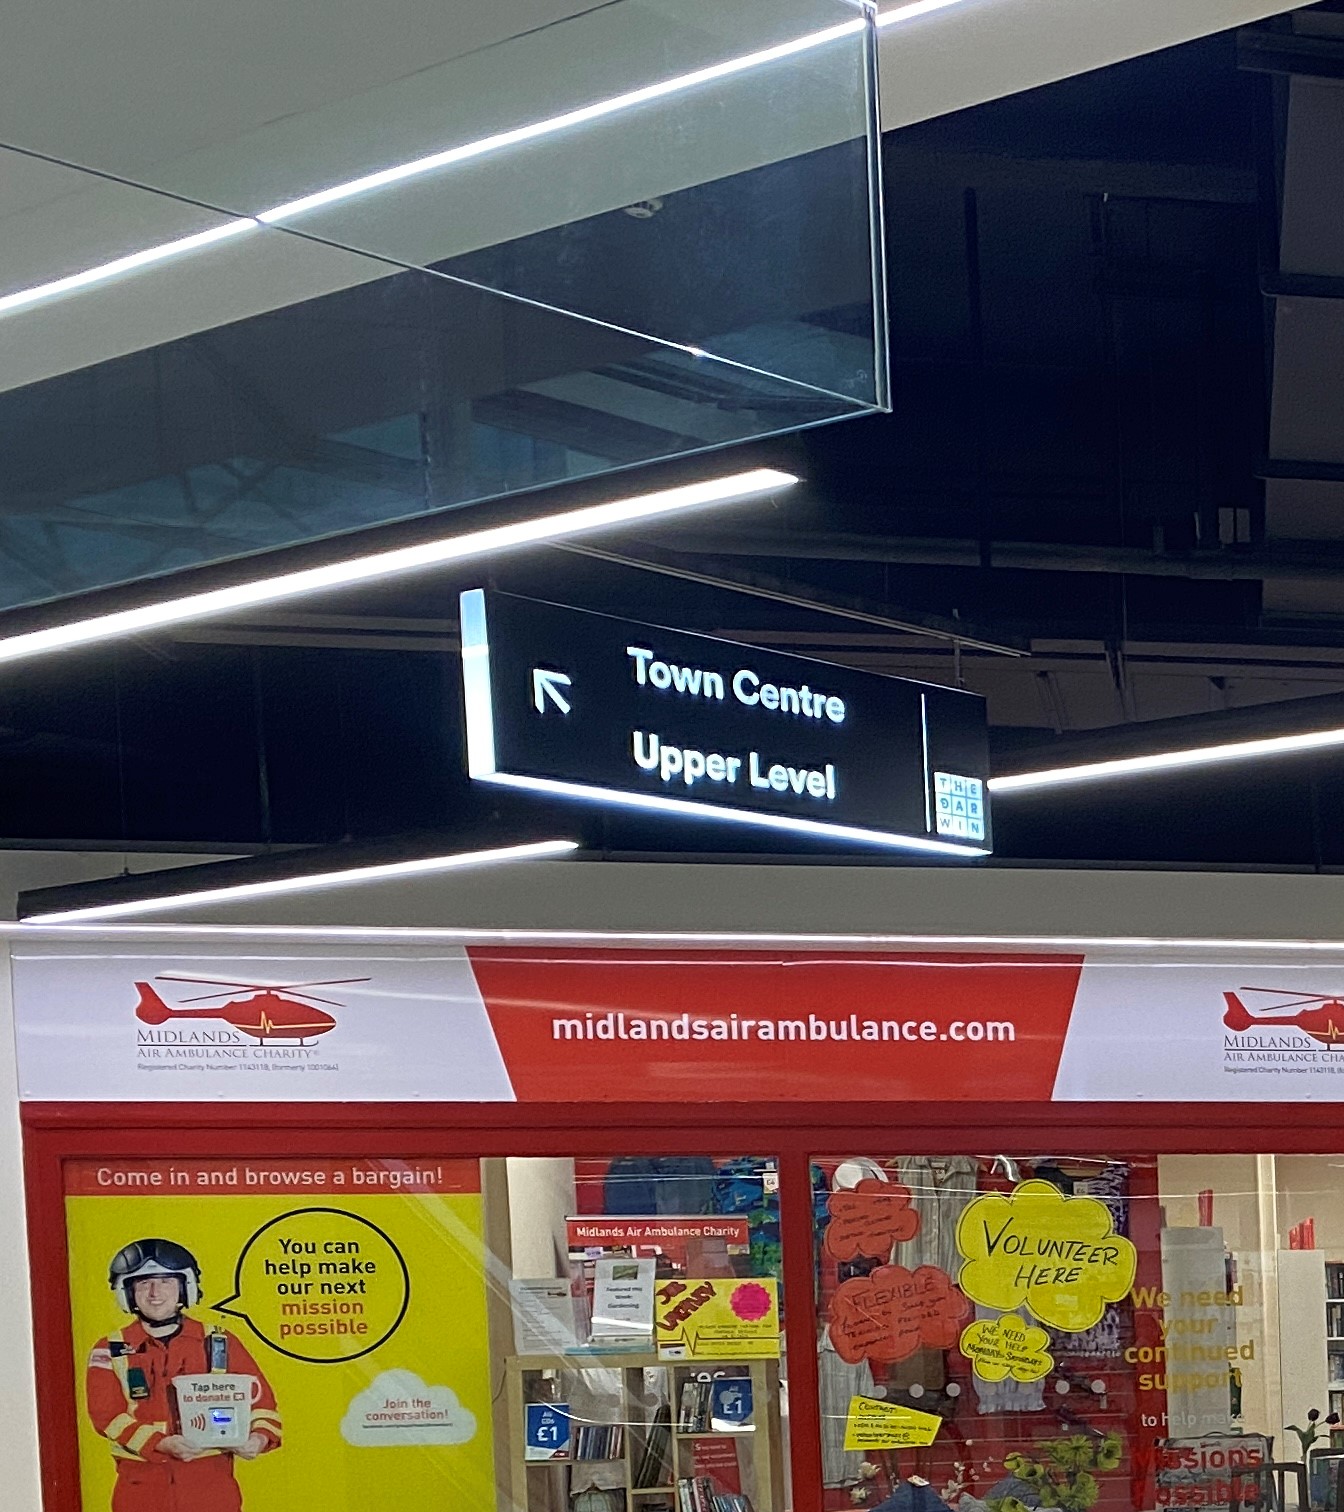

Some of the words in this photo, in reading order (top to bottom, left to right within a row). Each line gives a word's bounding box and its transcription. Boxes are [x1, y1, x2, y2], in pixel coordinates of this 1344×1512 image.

[627, 646, 725, 701] Town
[732, 669, 846, 723] Centre
[633, 731, 740, 785] Upper
[749, 752, 837, 800] Level
[940, 778, 977, 794] THE
[552, 1013, 1016, 1043] midlandsairambulance.com
[137, 1029, 240, 1044] MIDLANDS
[1224, 1035, 1312, 1049] MIDLANDS
[137, 1048, 162, 1059] AIR
[165, 1048, 250, 1059] AMBULANCE
[1224, 1053, 1247, 1063] AIR
[1248, 1053, 1318, 1063] AMBULANCE
[97, 1168, 163, 1186] Come
[170, 1168, 190, 1186] in
[198, 1167, 238, 1186] and
[246, 1167, 326, 1185] browse
[333, 1171, 345, 1185] a
[353, 1167, 443, 1189] bargain!
[576, 1225, 625, 1238] Midlands
[626, 1225, 642, 1238] Air
[644, 1225, 702, 1238] Ambulance
[703, 1225, 740, 1239] Charity
[279, 1239, 316, 1255] You
[323, 1240, 360, 1254] can
[983, 1216, 1120, 1267] VOLUNTEER
[265, 1259, 312, 1278] help
[318, 1258, 376, 1275] make
[1014, 1265, 1084, 1290] HERE
[277, 1280, 314, 1295] our
[321, 1279, 367, 1294] next
[852, 1277, 935, 1310] FLEXIBLE
[1131, 1286, 1172, 1309] We
[1180, 1285, 1244, 1307] need
[282, 1300, 364, 1316] mission
[280, 1319, 368, 1339] possible
[1158, 1317, 1219, 1341] your
[1124, 1339, 1255, 1364] continued
[191, 1382, 210, 1394] Tap
[211, 1382, 236, 1392] here
[1139, 1368, 1242, 1394] support
[184, 1394, 193, 1402] to
[195, 1392, 231, 1402] donate
[382, 1398, 409, 1411] Join
[411, 1398, 432, 1410] the
[722, 1399, 742, 1414] £1
[365, 1409, 449, 1422] conversation!
[1141, 1413, 1157, 1427] to
[1161, 1412, 1197, 1428] help
[536, 1426, 559, 1442] £1
